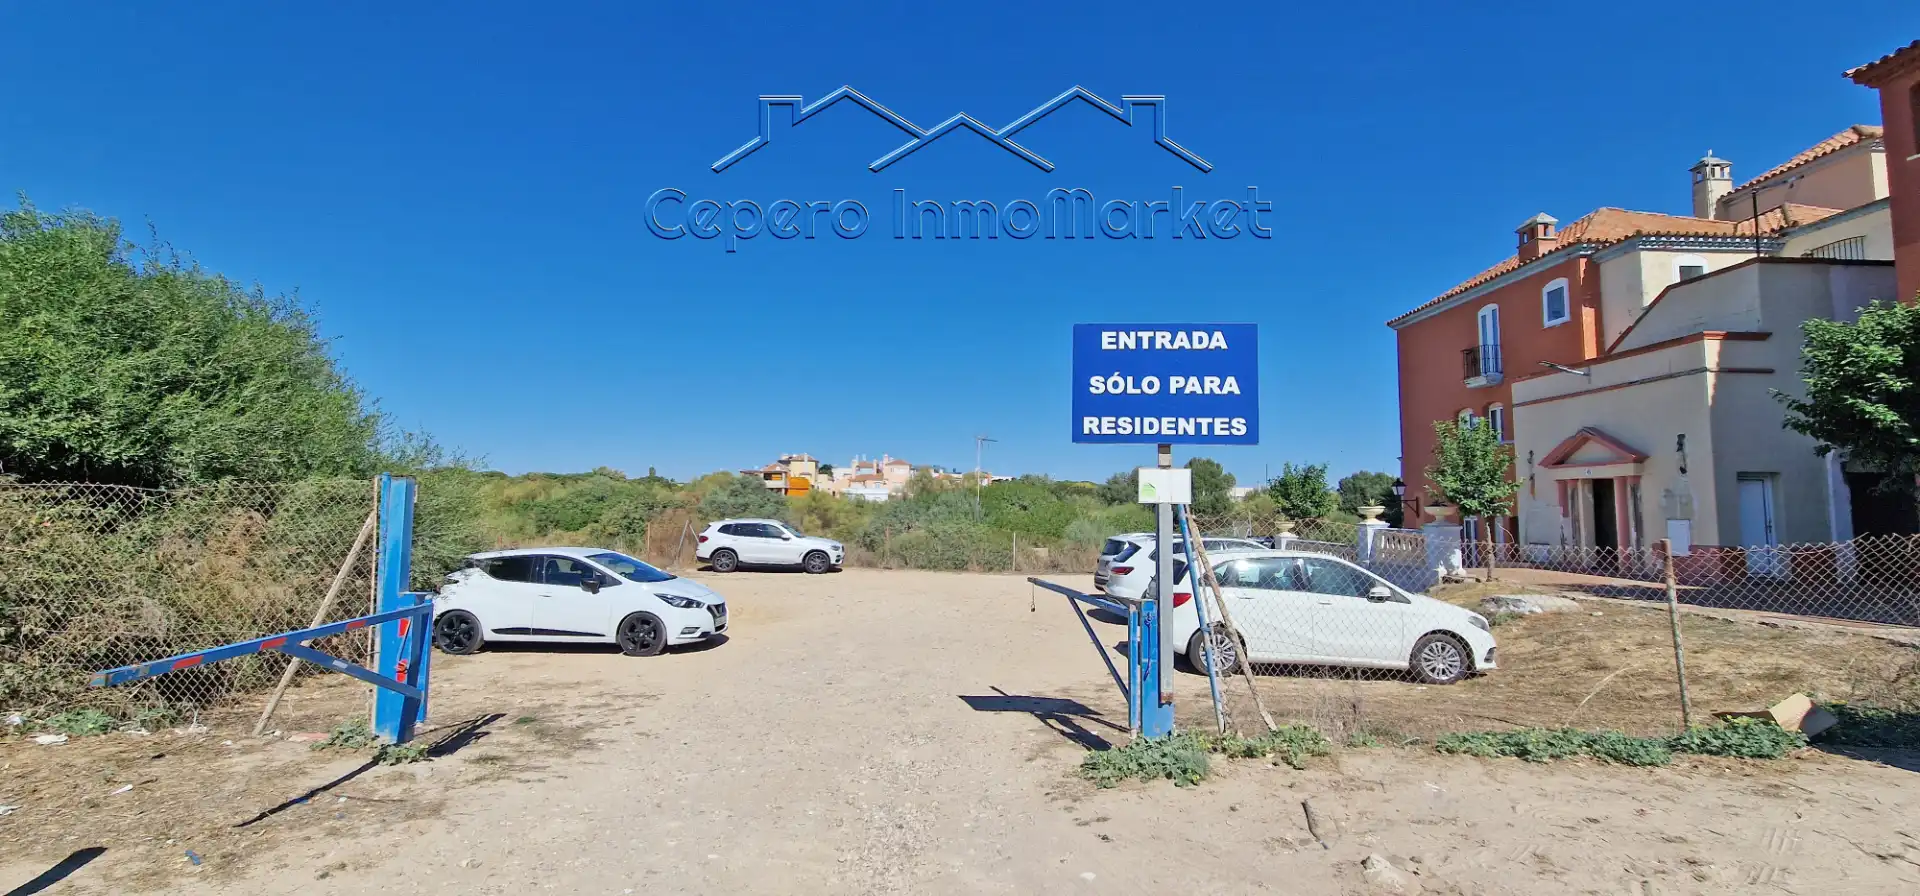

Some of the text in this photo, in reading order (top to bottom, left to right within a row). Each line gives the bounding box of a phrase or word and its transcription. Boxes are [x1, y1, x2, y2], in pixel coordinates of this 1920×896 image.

[1101, 331, 1228, 350] ENTRADA
[1089, 372, 1241, 395] SÓLO PARA
[1082, 416, 1247, 436] RESIDENTES
